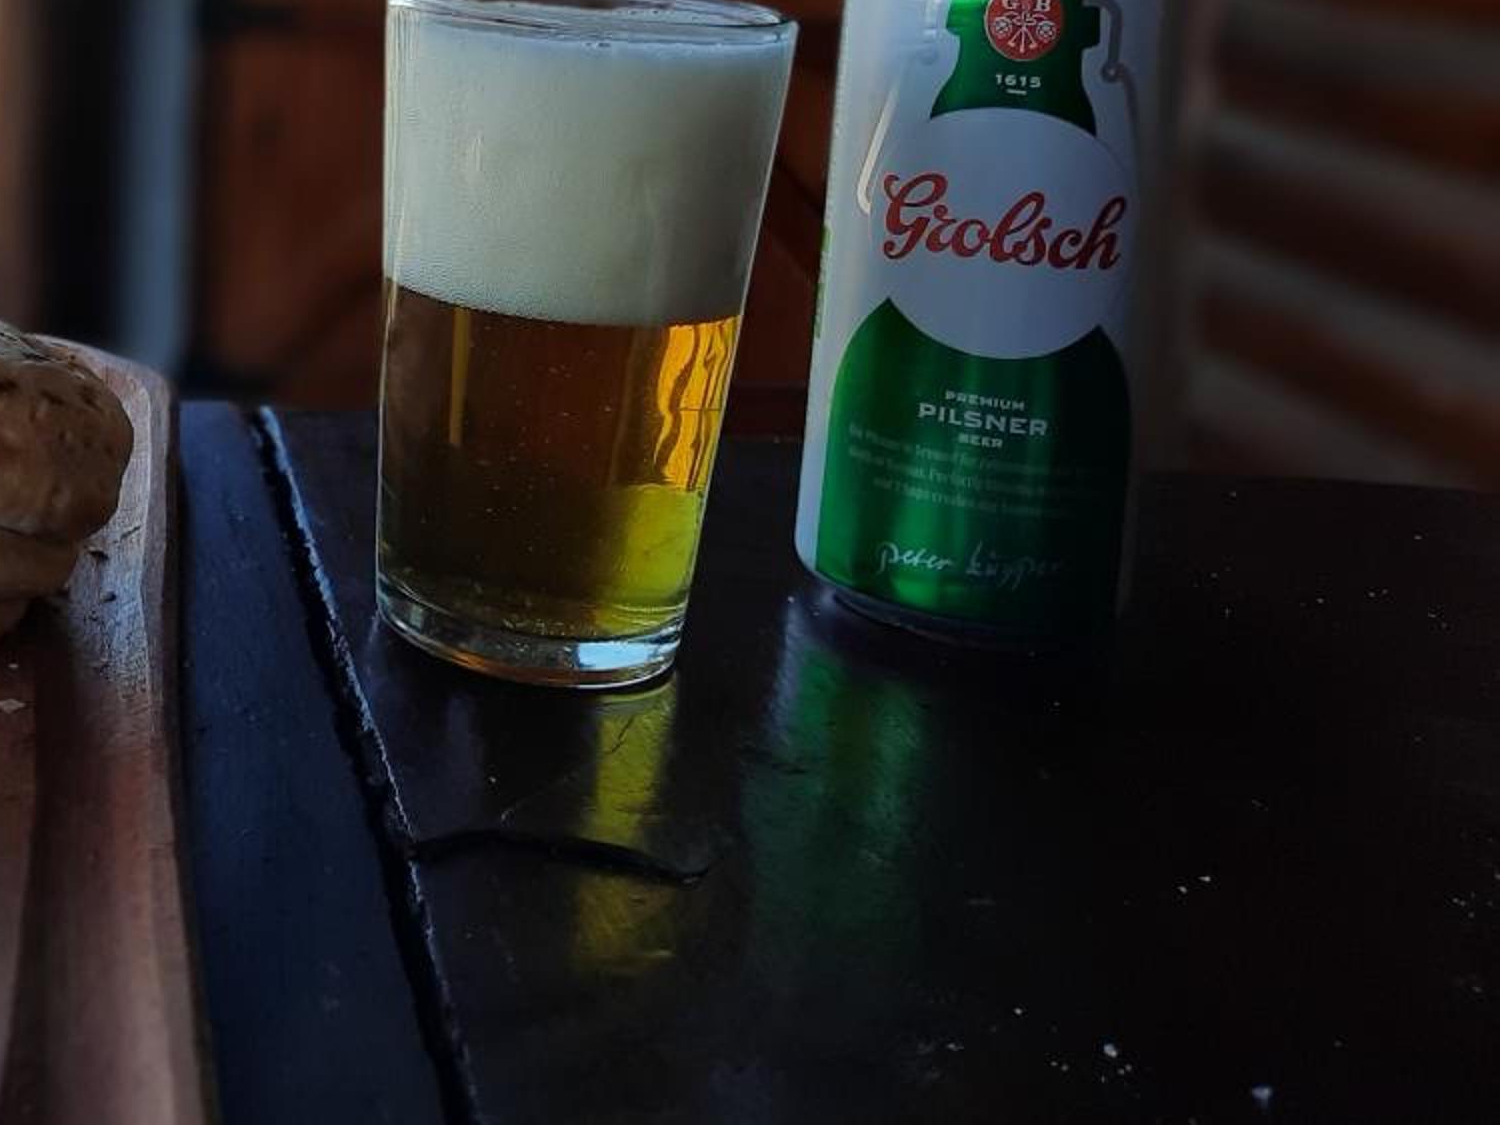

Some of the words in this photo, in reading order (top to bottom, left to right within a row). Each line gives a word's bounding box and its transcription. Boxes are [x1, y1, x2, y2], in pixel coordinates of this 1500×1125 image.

[995, 73, 1041, 88] 1615
[883, 173, 1127, 270] Grolsch
[945, 389, 1025, 412] PREMIUM
[918, 405, 1048, 436] PILSNER
[957, 432, 1003, 449] BEER
